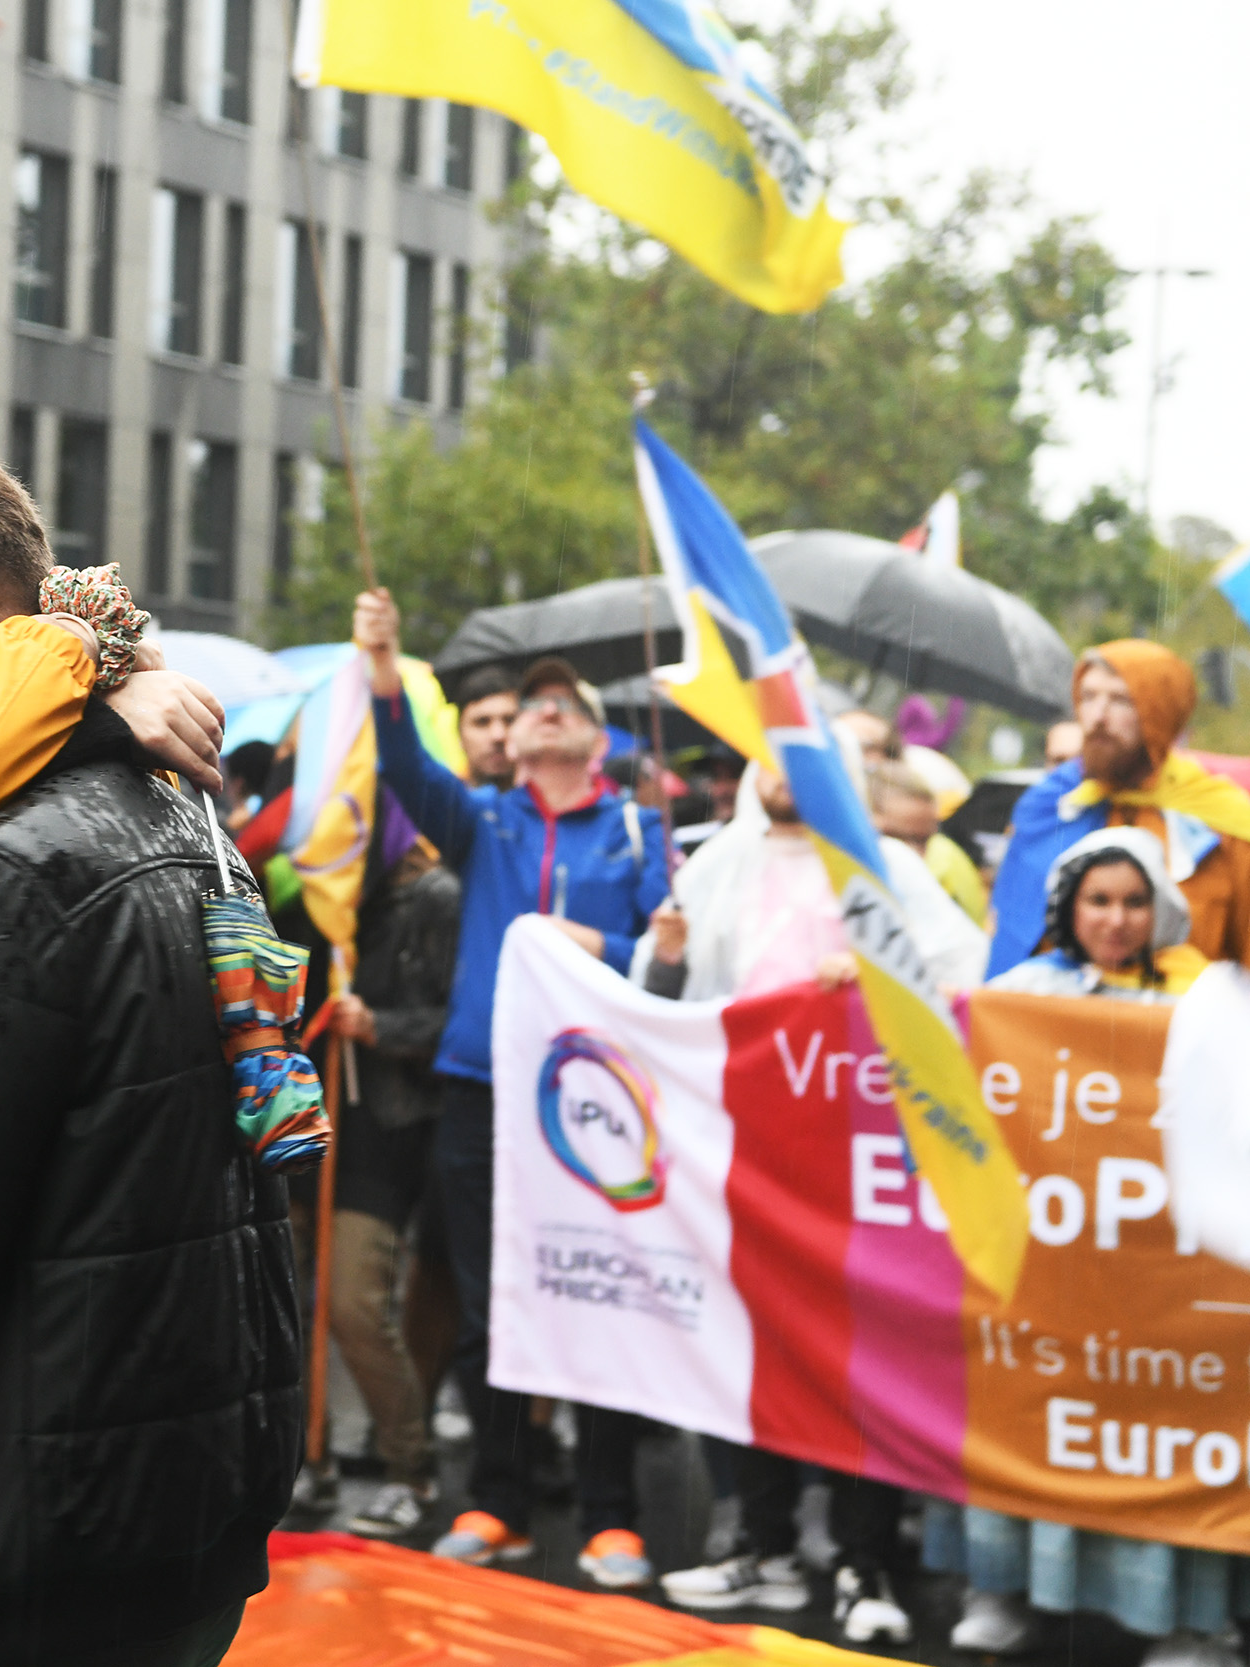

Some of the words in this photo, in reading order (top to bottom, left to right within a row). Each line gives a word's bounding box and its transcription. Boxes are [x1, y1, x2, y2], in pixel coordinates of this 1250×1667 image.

[773, 1028, 1022, 1116] Vree
[1042, 1048, 1121, 1140] je
[536, 1244, 704, 1302] EUROPAN
[980, 1314, 1066, 1376] It's
[1083, 1330, 1226, 1392] time
[1046, 1397, 1250, 1488] Euro
